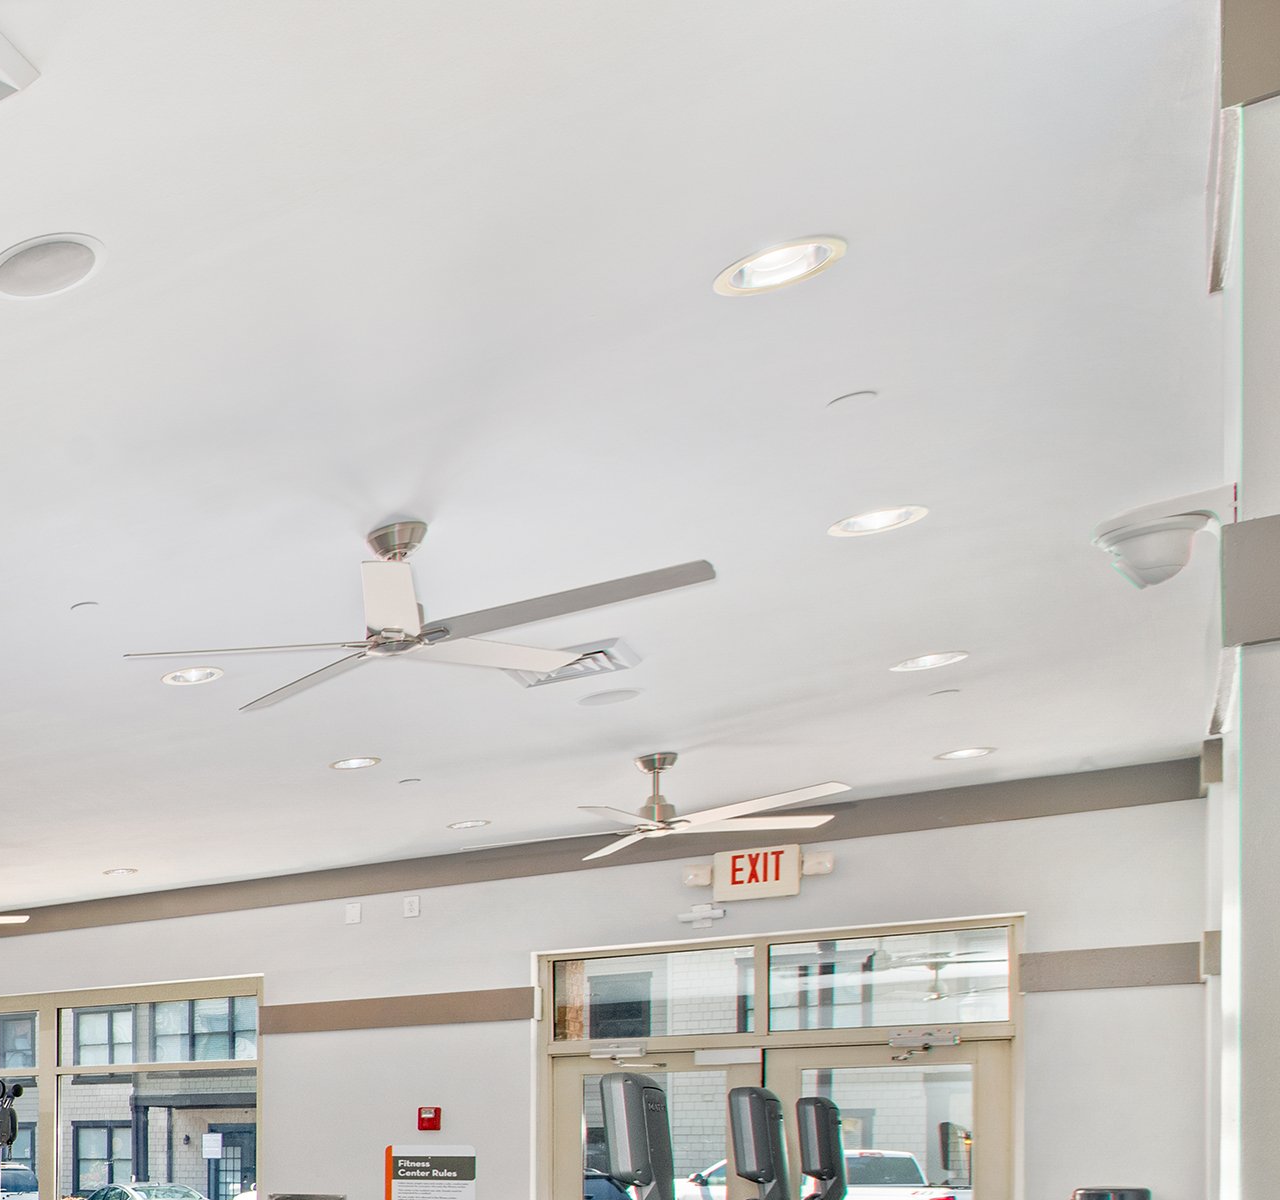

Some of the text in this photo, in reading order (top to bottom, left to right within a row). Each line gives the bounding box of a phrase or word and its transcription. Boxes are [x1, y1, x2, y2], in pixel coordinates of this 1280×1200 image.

[731, 850, 784, 885] EXIT
[398, 1159, 431, 1168] Fitness
[397, 1169, 458, 1177] Center Rules
